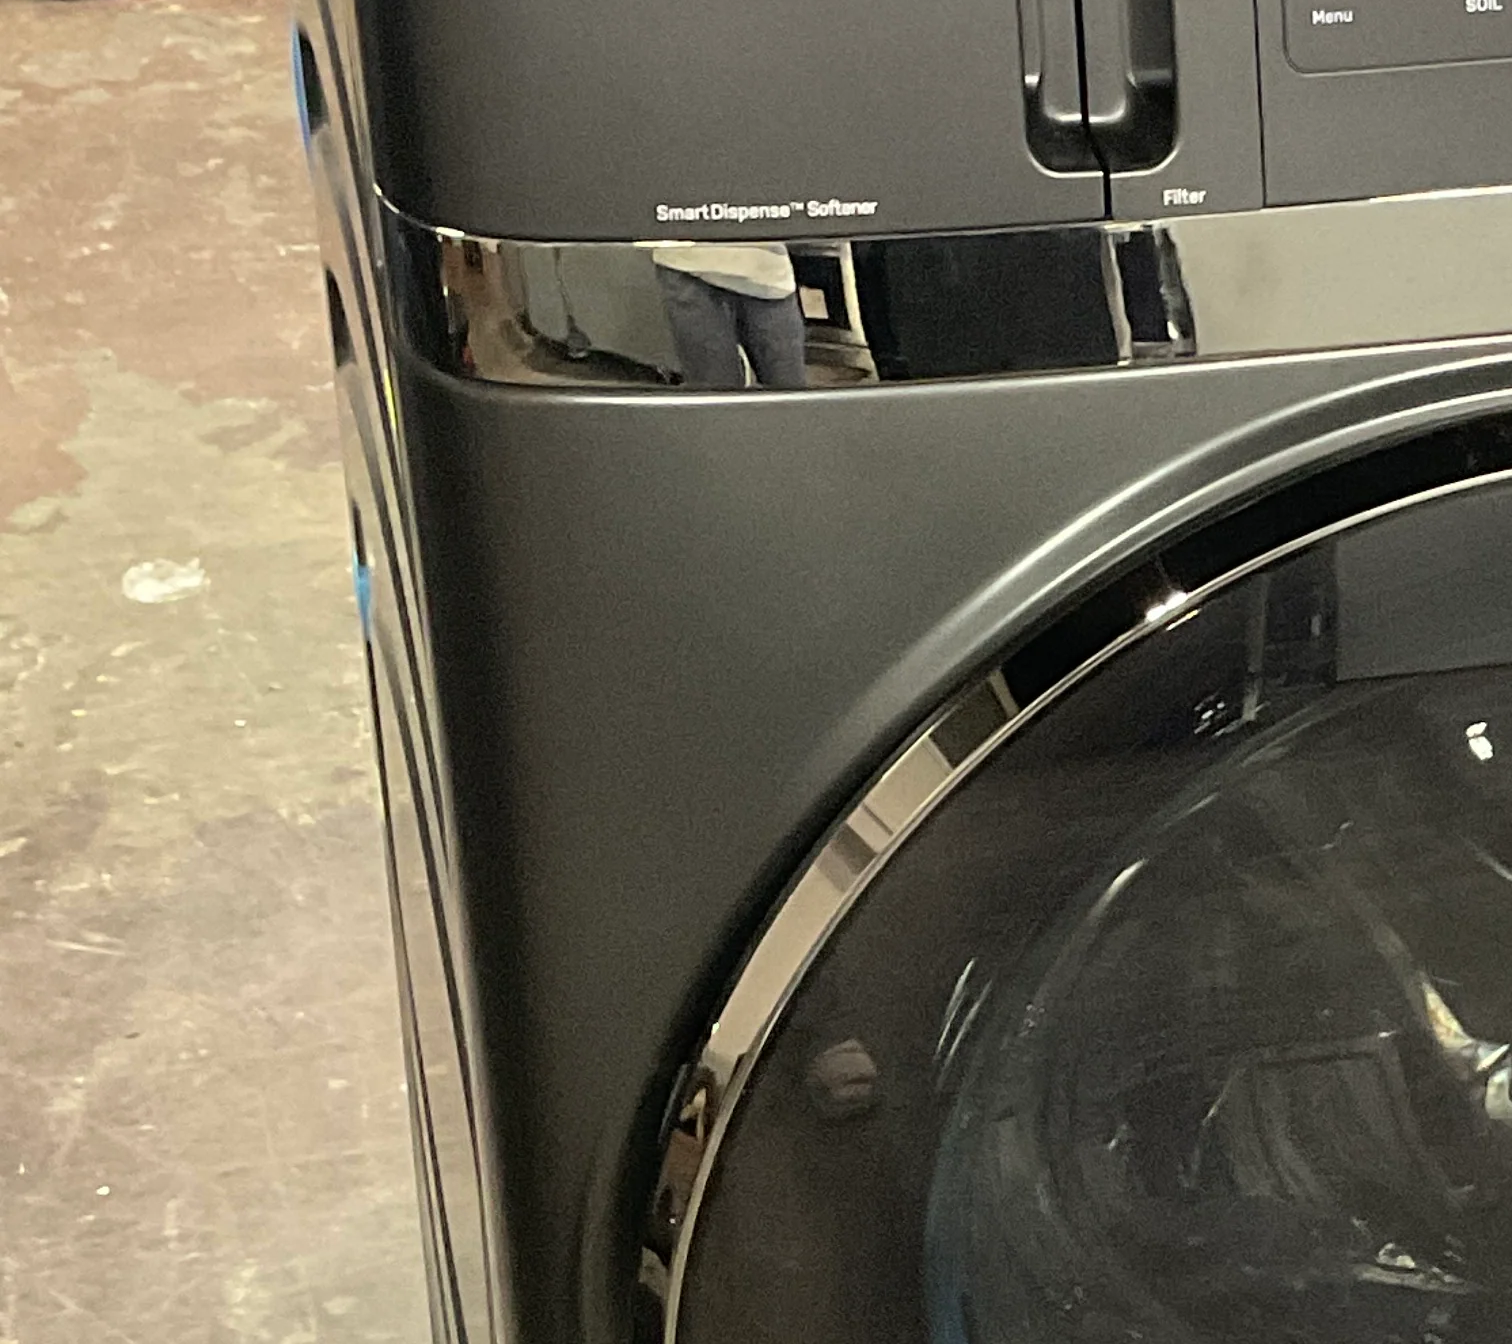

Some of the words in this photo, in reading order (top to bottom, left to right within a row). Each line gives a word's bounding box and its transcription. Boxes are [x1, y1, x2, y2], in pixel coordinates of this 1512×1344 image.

[1312, 8, 1353, 25] Menu
[1163, 189, 1207, 206] Filter
[806, 197, 878, 217] Softener
